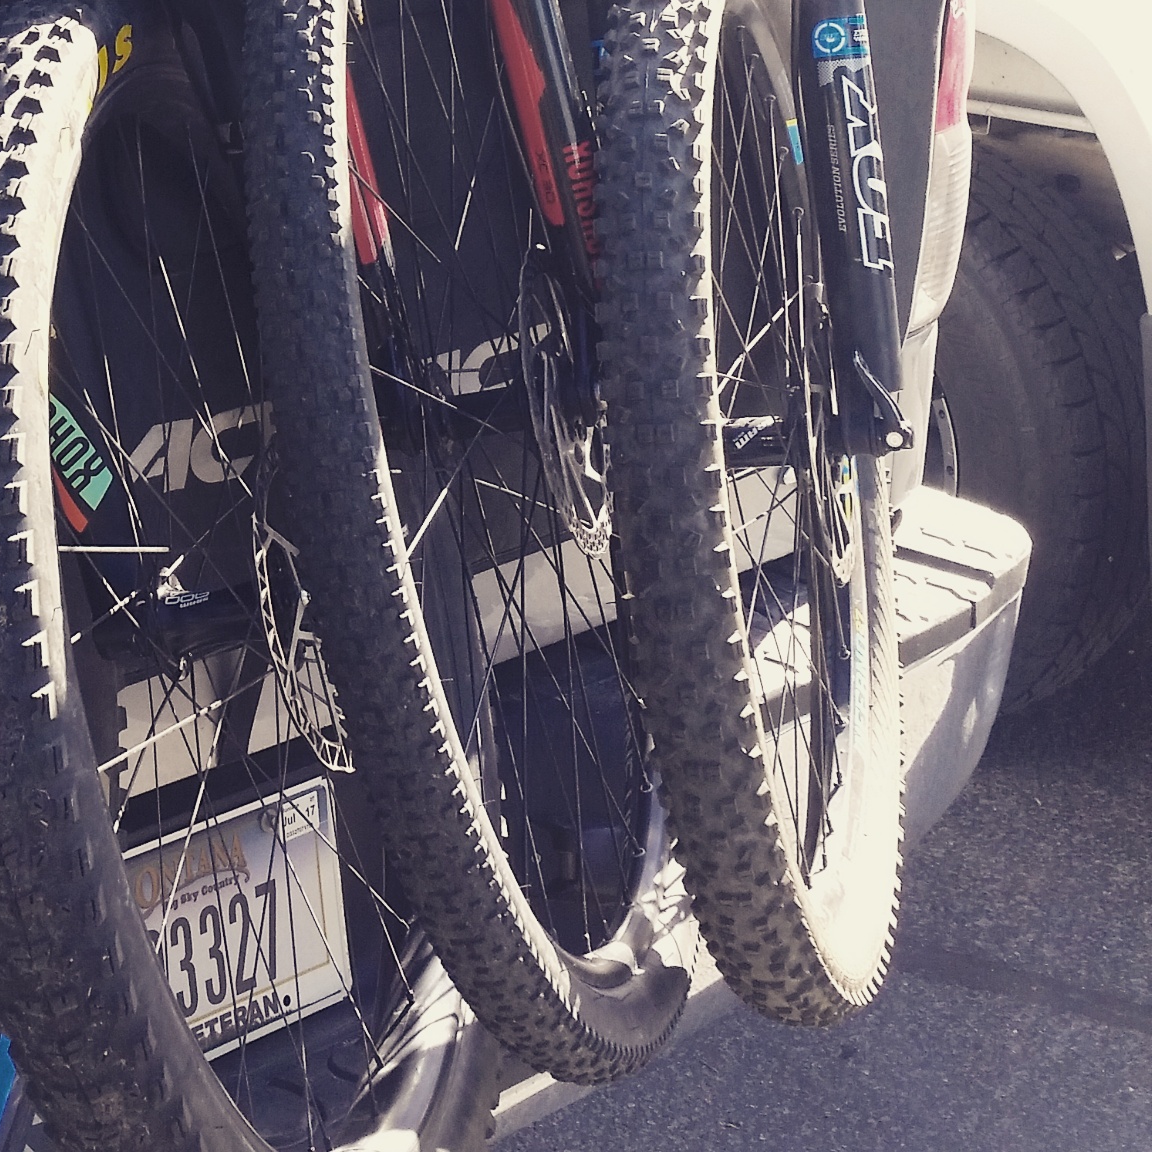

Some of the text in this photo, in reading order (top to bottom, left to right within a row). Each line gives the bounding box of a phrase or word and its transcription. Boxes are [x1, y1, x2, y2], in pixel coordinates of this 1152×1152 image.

[826, 124, 847, 233] EVOLUTION SERIES
[305, 804, 315, 818] 17
[134, 832, 248, 911] ONTANA
[180, 890, 199, 906] Sky
[201, 873, 240, 896] Country
[148, 878, 277, 1019] 3327
